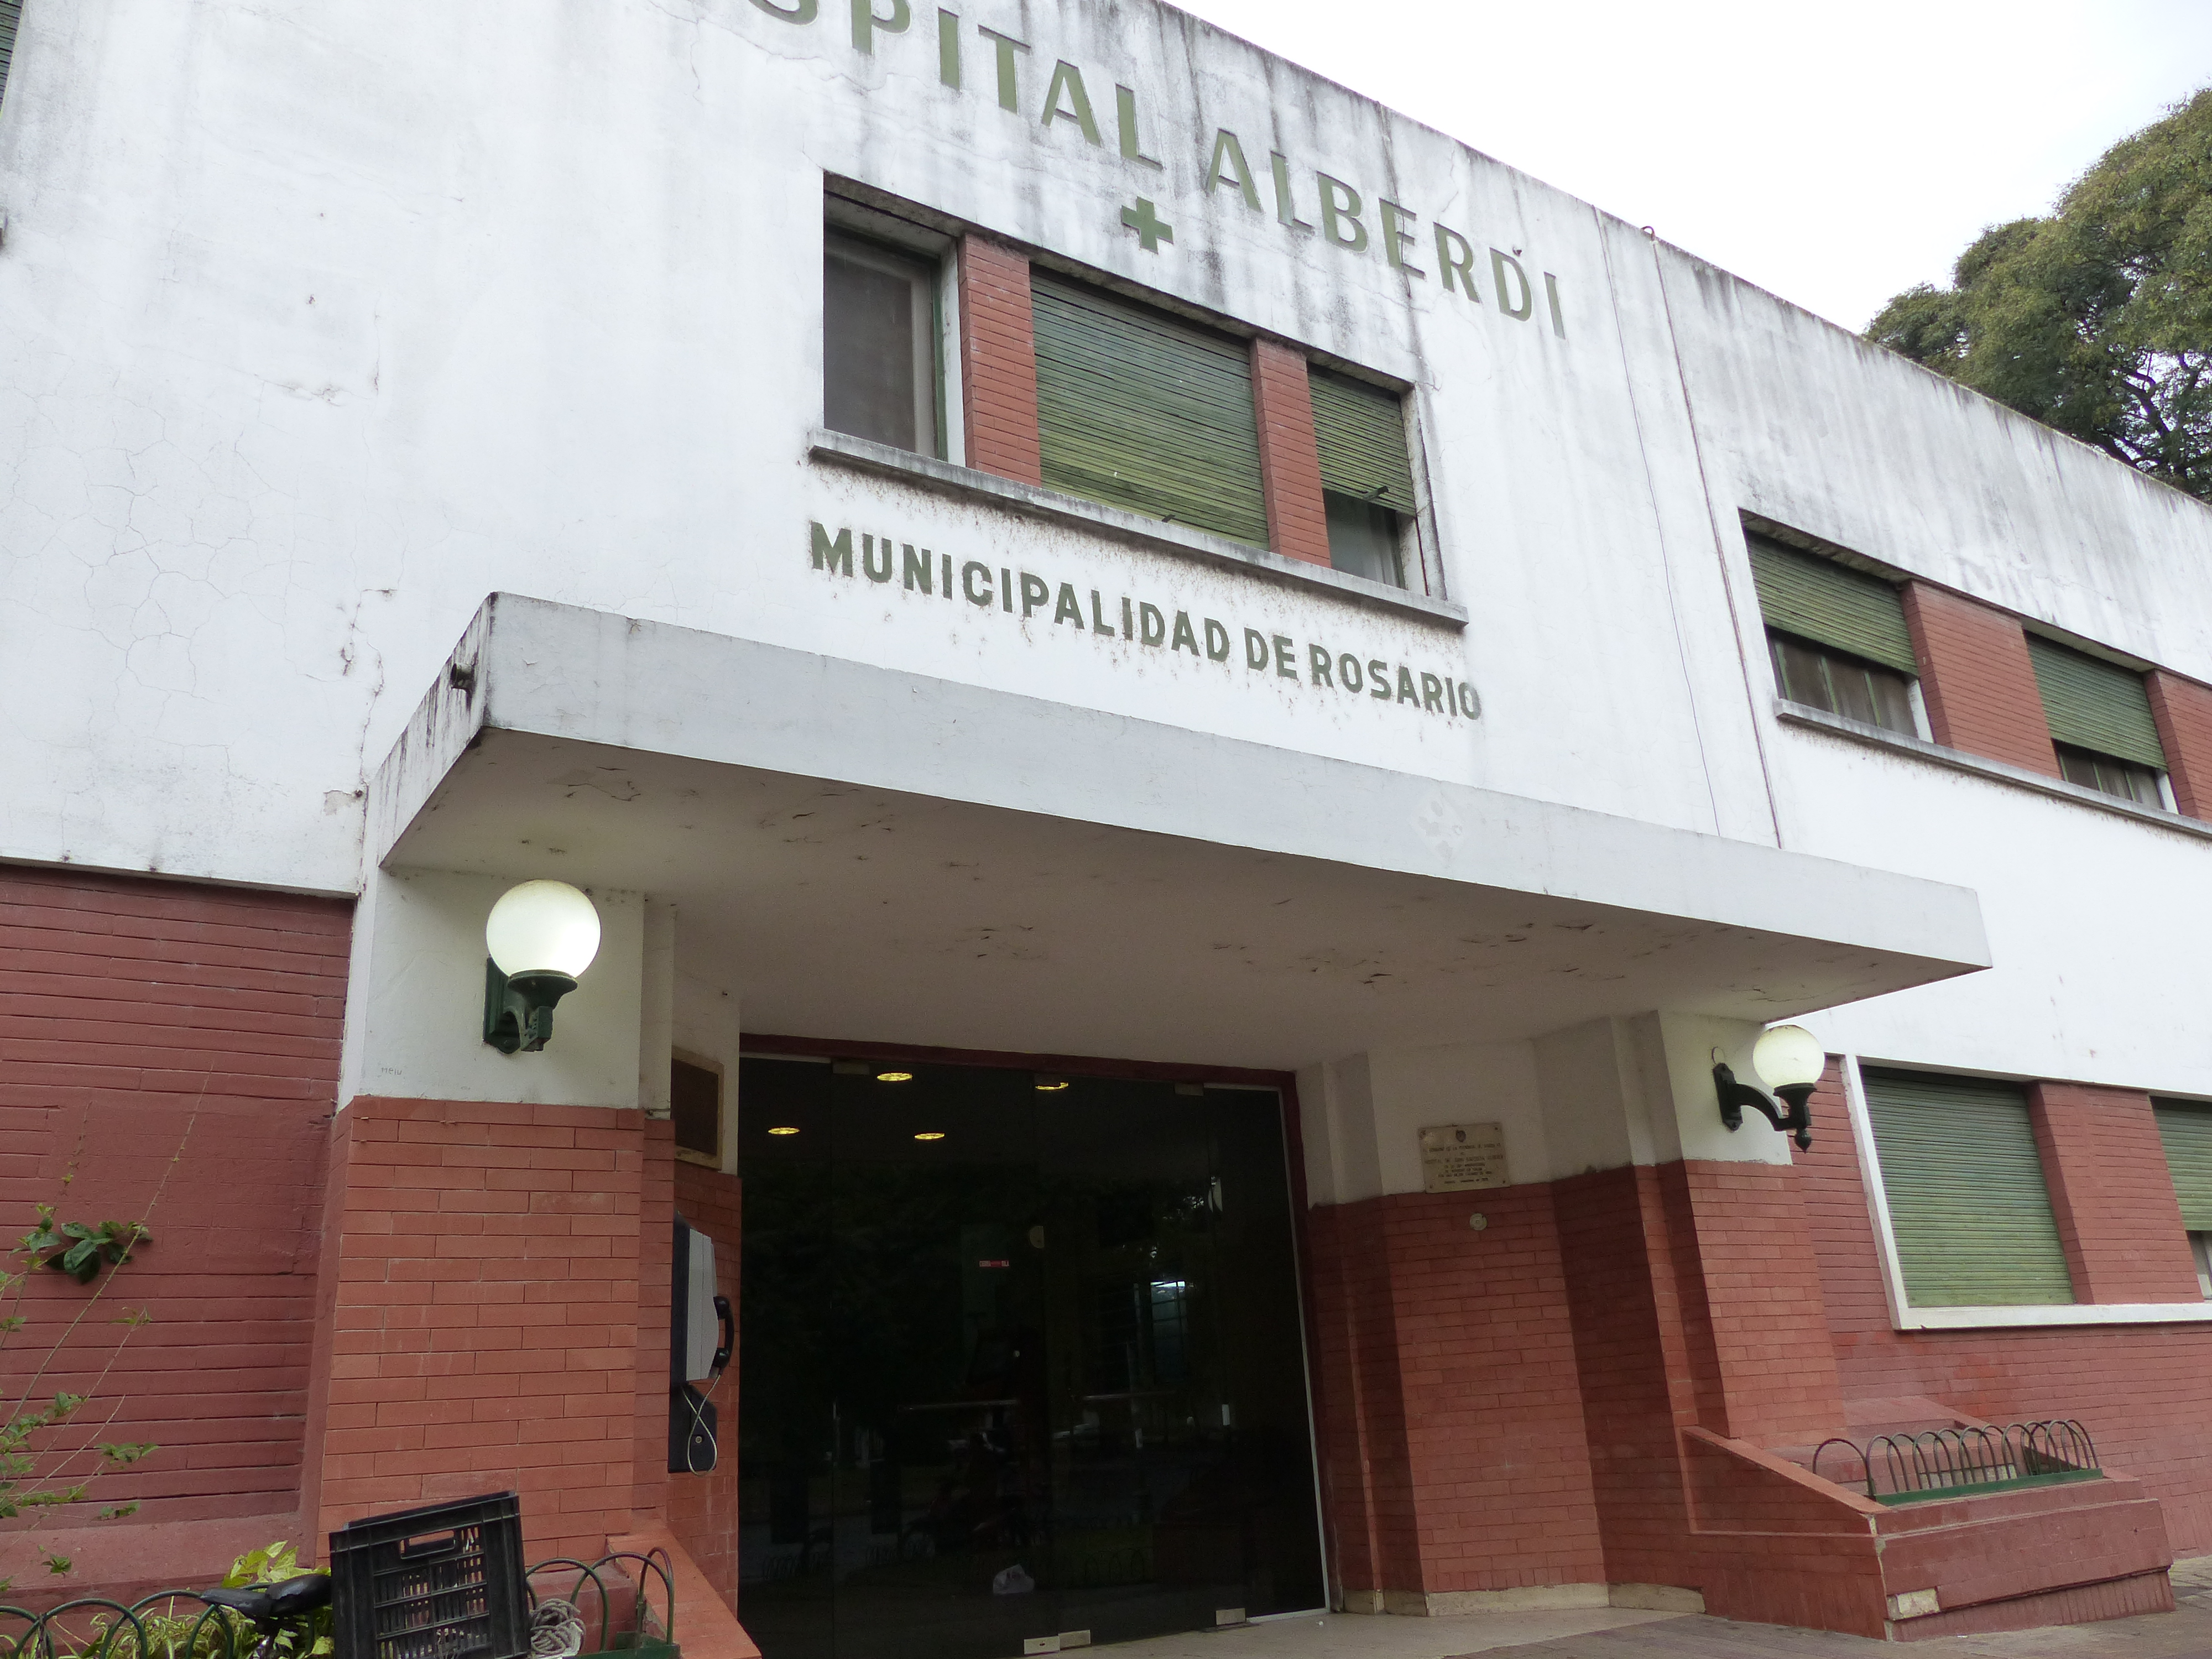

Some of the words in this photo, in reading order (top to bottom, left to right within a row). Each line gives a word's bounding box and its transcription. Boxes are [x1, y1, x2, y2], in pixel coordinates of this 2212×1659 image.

[749, 0, 1164, 171] PITAL
[1207, 128, 1566, 340] ALBERDI
[811, 521, 1230, 662] MUNICIPALIDAD
[1244, 627, 1298, 680] DE
[1308, 643, 1481, 720] ROSARIO
